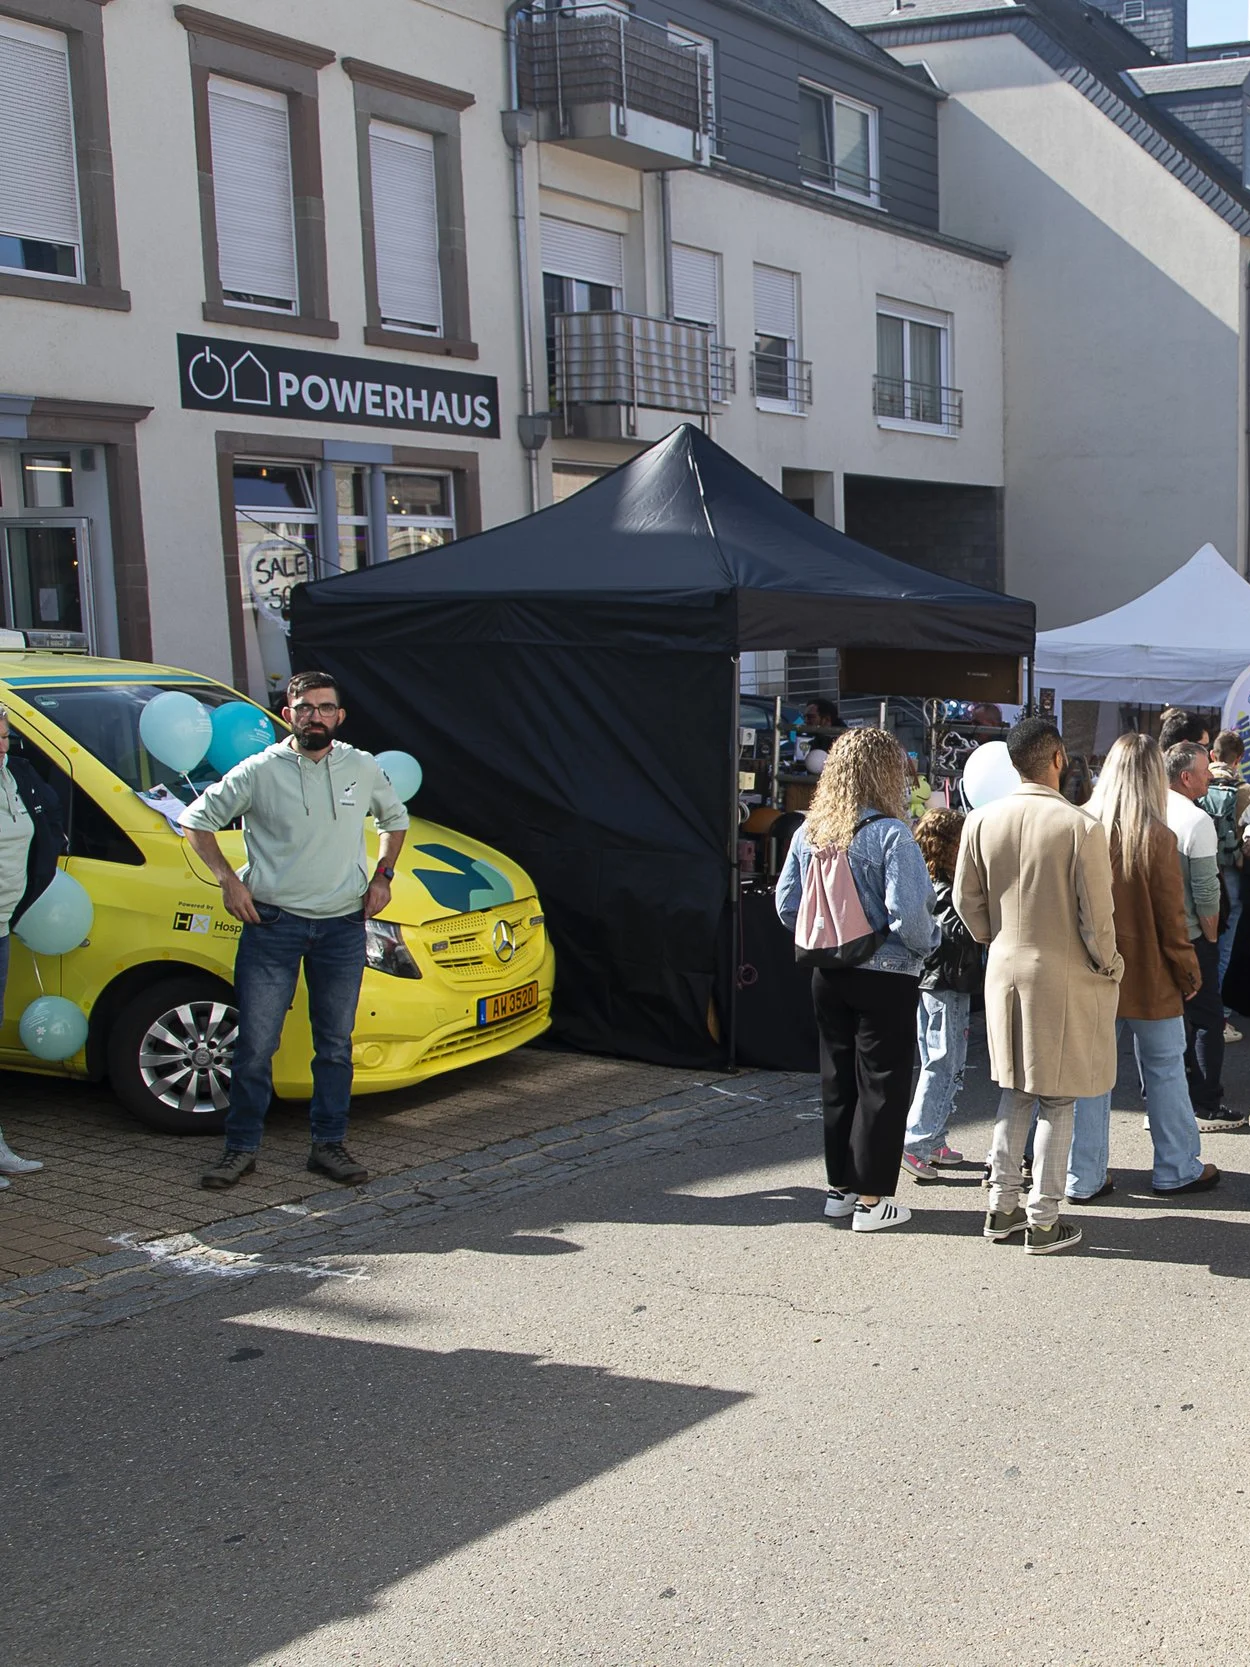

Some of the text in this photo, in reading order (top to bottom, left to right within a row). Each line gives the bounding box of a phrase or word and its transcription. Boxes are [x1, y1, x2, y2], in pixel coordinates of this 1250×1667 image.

[279, 371, 491, 428] POWERHAUS
[256, 553, 307, 584] SALE
[178, 901, 205, 911] Powered
[214, 920, 242, 936] Hosp
[509, 987, 533, 1013] 3520
